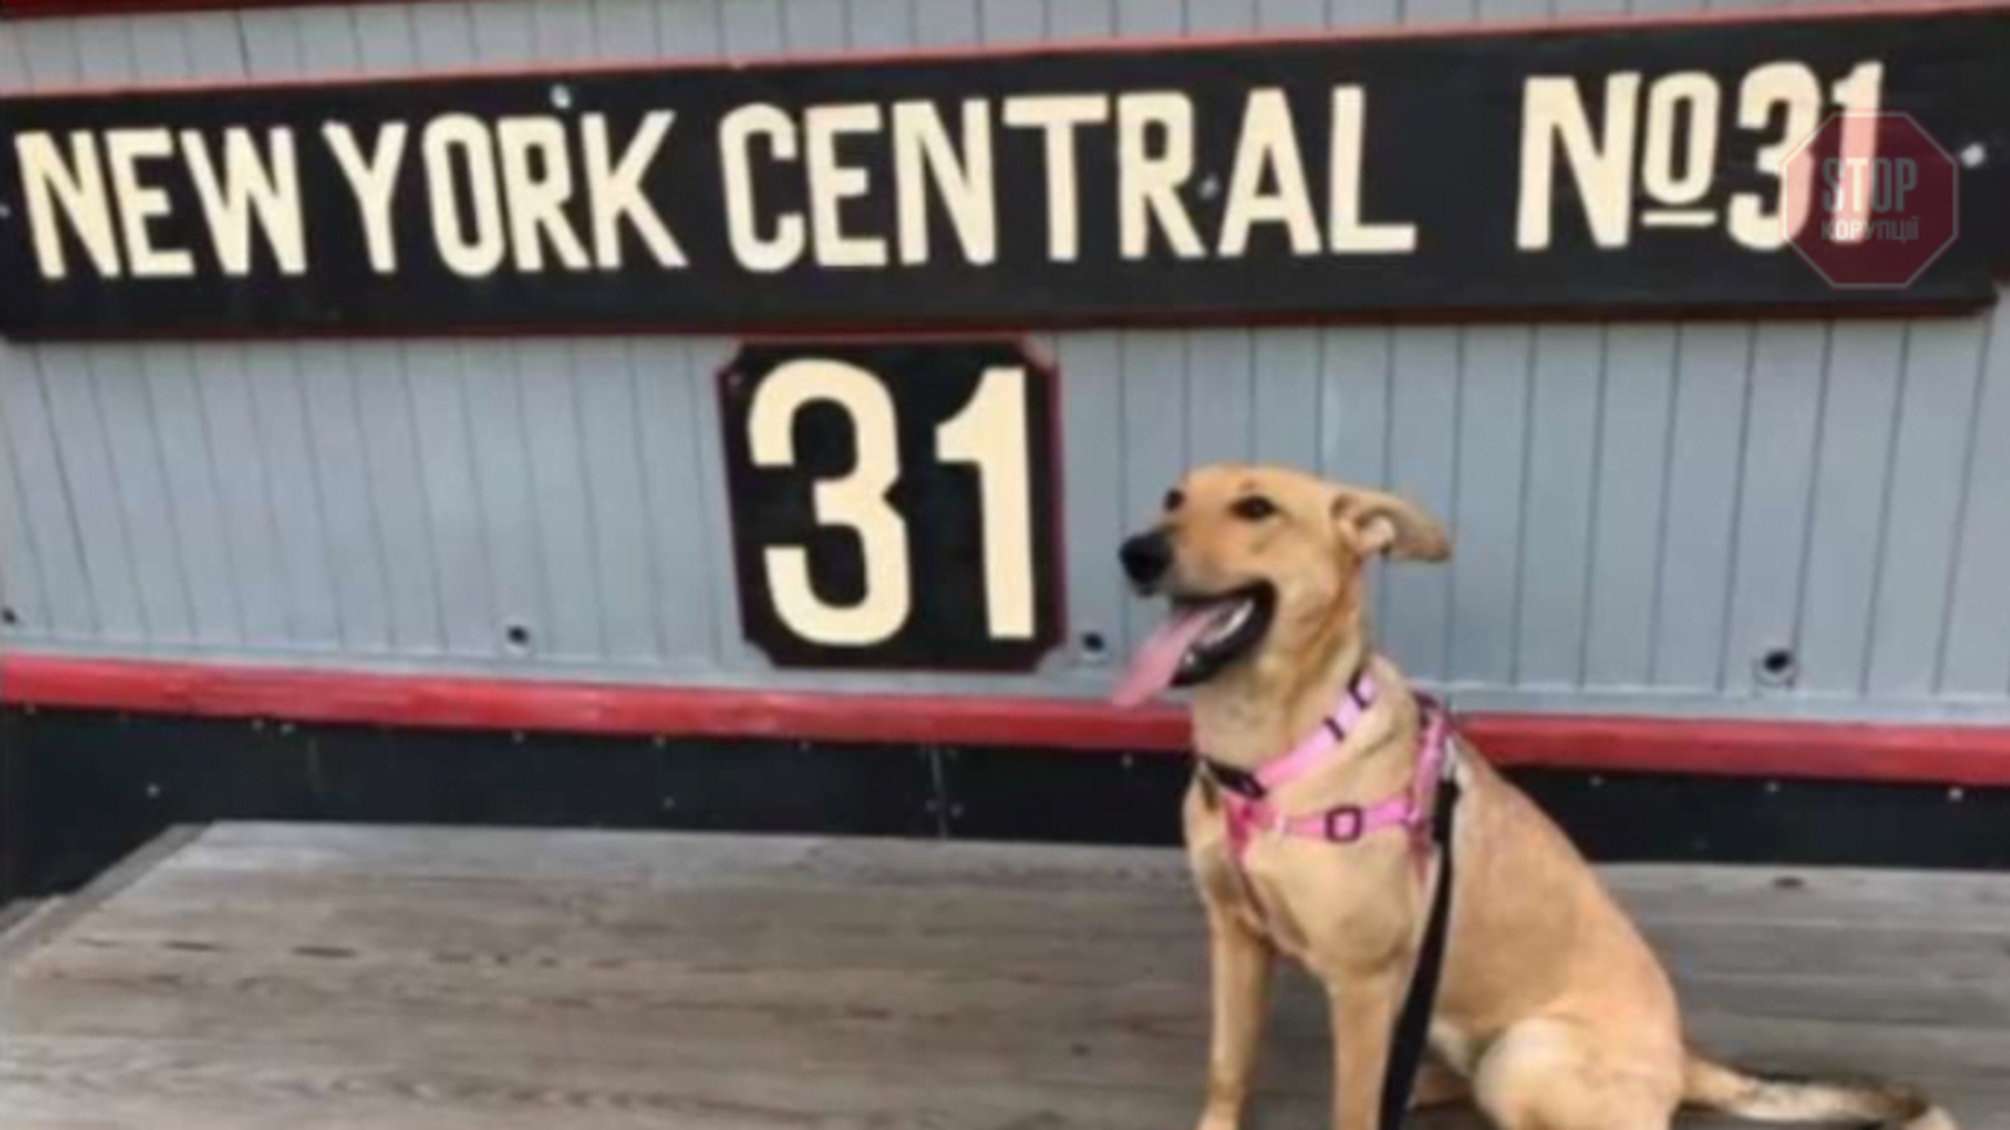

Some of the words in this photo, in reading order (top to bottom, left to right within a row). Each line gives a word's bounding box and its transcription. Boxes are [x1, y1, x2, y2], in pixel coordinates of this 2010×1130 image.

[16, 127, 308, 279] NEW
[323, 109, 687, 276] YORK
[719, 86, 1416, 272] CENTRAL
[748, 359, 1034, 646] 31
